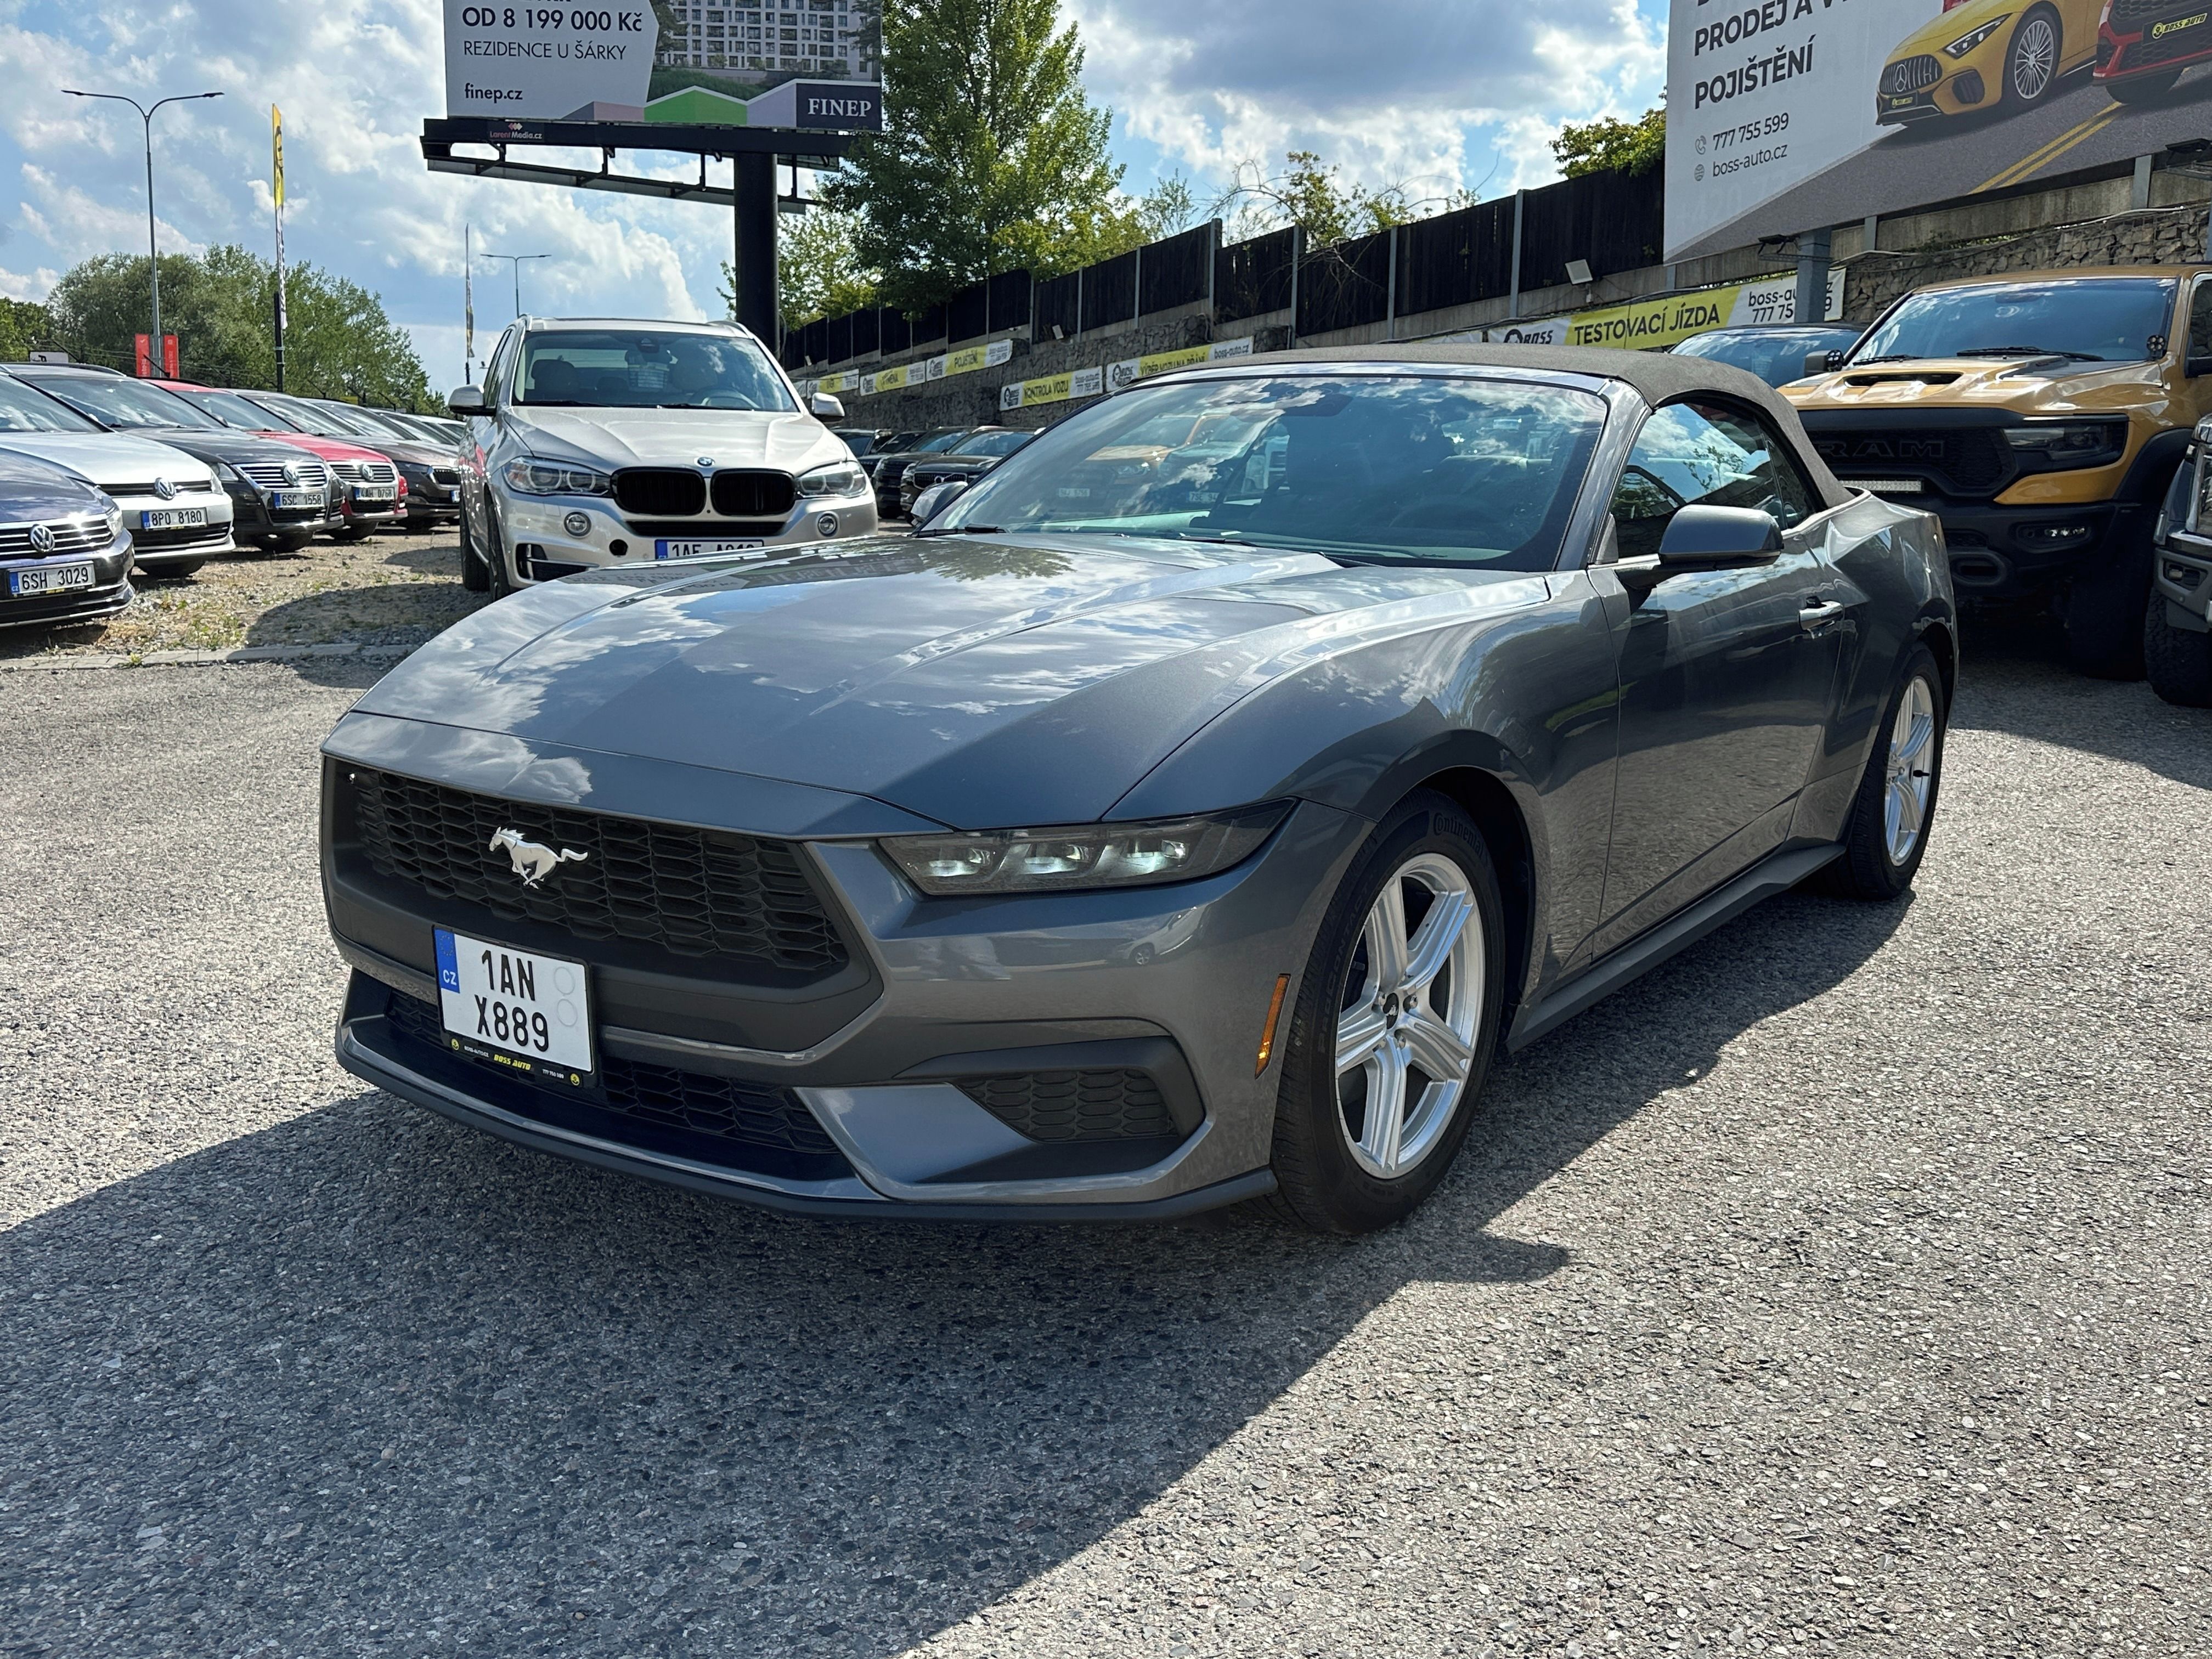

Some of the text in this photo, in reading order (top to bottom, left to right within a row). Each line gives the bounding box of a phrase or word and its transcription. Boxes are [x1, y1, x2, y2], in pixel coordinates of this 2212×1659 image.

[462, 7, 642, 31] OD 8 199 000 Kč
[1694, 0, 1787, 57] PRODEJ
[464, 40, 627, 60] REZIDENCE U ŠÁRKY
[1695, 34, 1816, 109] POJIŠTĚNÍ
[465, 83, 523, 103] finep.cz
[808, 98, 871, 117] FINEP
[1713, 112, 1789, 150] 777 755 599
[1713, 145, 1788, 177] boss-auto.cz
[1575, 303, 1720, 346] TESTOVACÍ JÍZDA
[1752, 306, 1775, 323] 777
[1813, 441, 1944, 457] RAM
[282, 494, 322, 505] 6SC 1558
[178, 510, 202, 524] 8180
[22, 567, 88, 590] 6SH 3029
[1434, 812, 1484, 859] Continental
[443, 969, 457, 985] CZ
[482, 950, 535, 1001] 1AN
[474, 994, 549, 1052] X889
[494, 1054, 511, 1065] BOSS
[512, 1060, 532, 1070] AUTO
